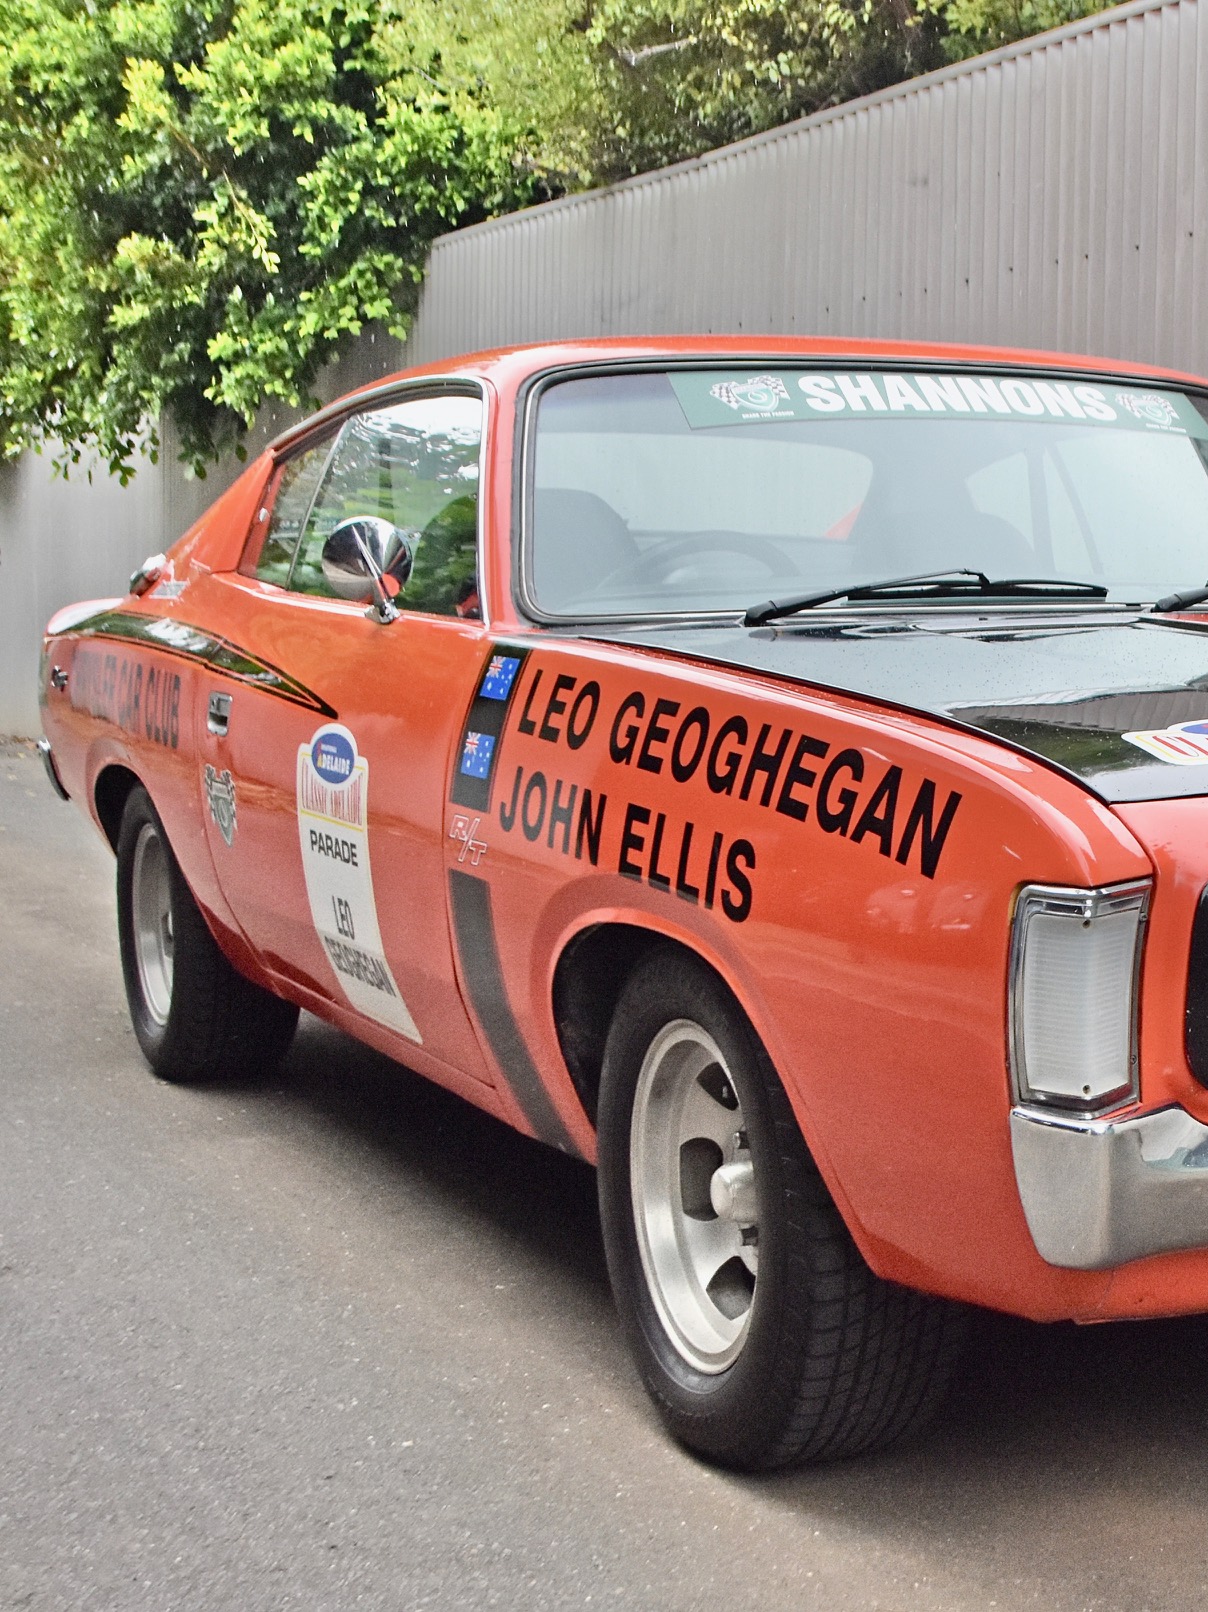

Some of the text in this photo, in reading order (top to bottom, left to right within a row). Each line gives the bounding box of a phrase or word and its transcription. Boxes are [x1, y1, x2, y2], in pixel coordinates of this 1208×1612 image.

[797, 374, 1118, 422] SHANNONS
[145, 666, 181, 749] CLUB
[516, 668, 963, 880] LEO GEOGHEGAN
[309, 829, 359, 867] PARADE
[448, 814, 488, 866] R/T
[500, 765, 757, 923] JOHN ELLIS
[332, 895, 355, 940] LEO
